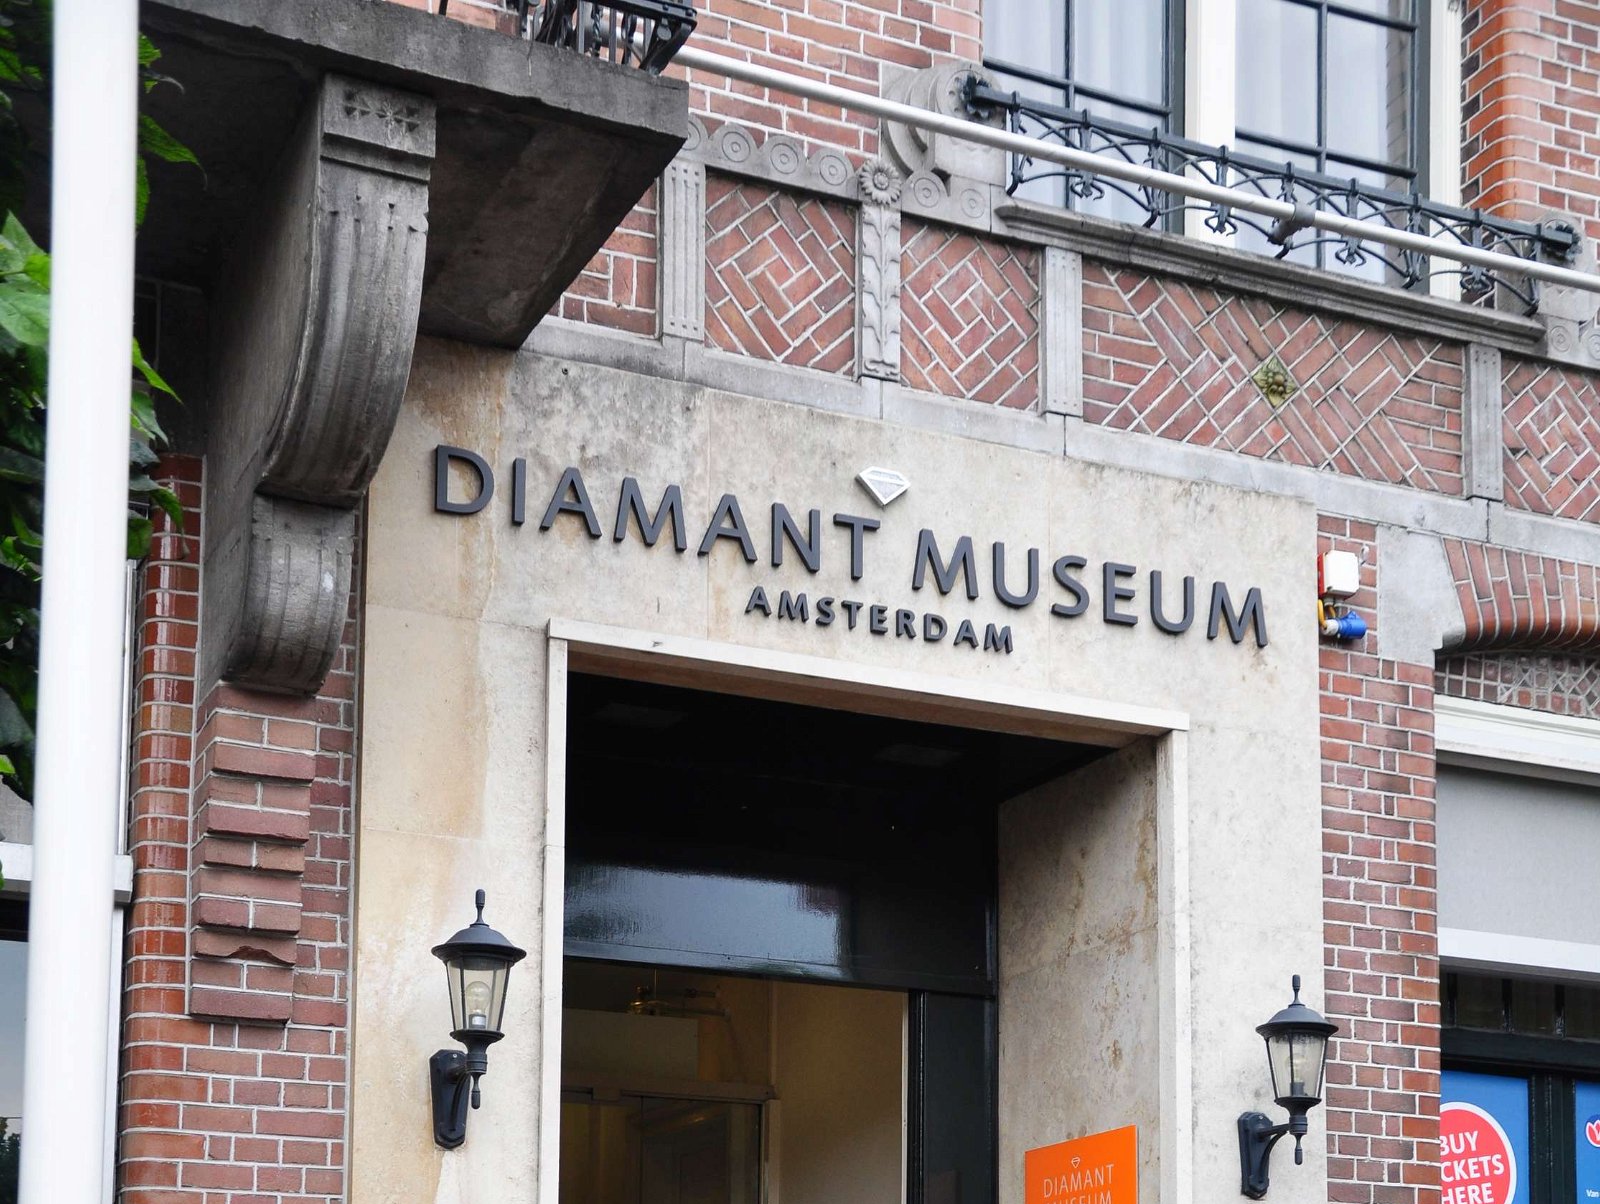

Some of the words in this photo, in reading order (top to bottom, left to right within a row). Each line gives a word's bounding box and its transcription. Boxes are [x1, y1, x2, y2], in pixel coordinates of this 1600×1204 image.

[435, 444, 881, 581] DIAMANT
[912, 529, 1269, 648] MUSEUM
[745, 585, 1014, 654] AMSTERDAM
[1439, 1131, 1478, 1156] BUY
[1043, 1163, 1114, 1199] DIAMANT
[1440, 1154, 1505, 1182] CKETS
